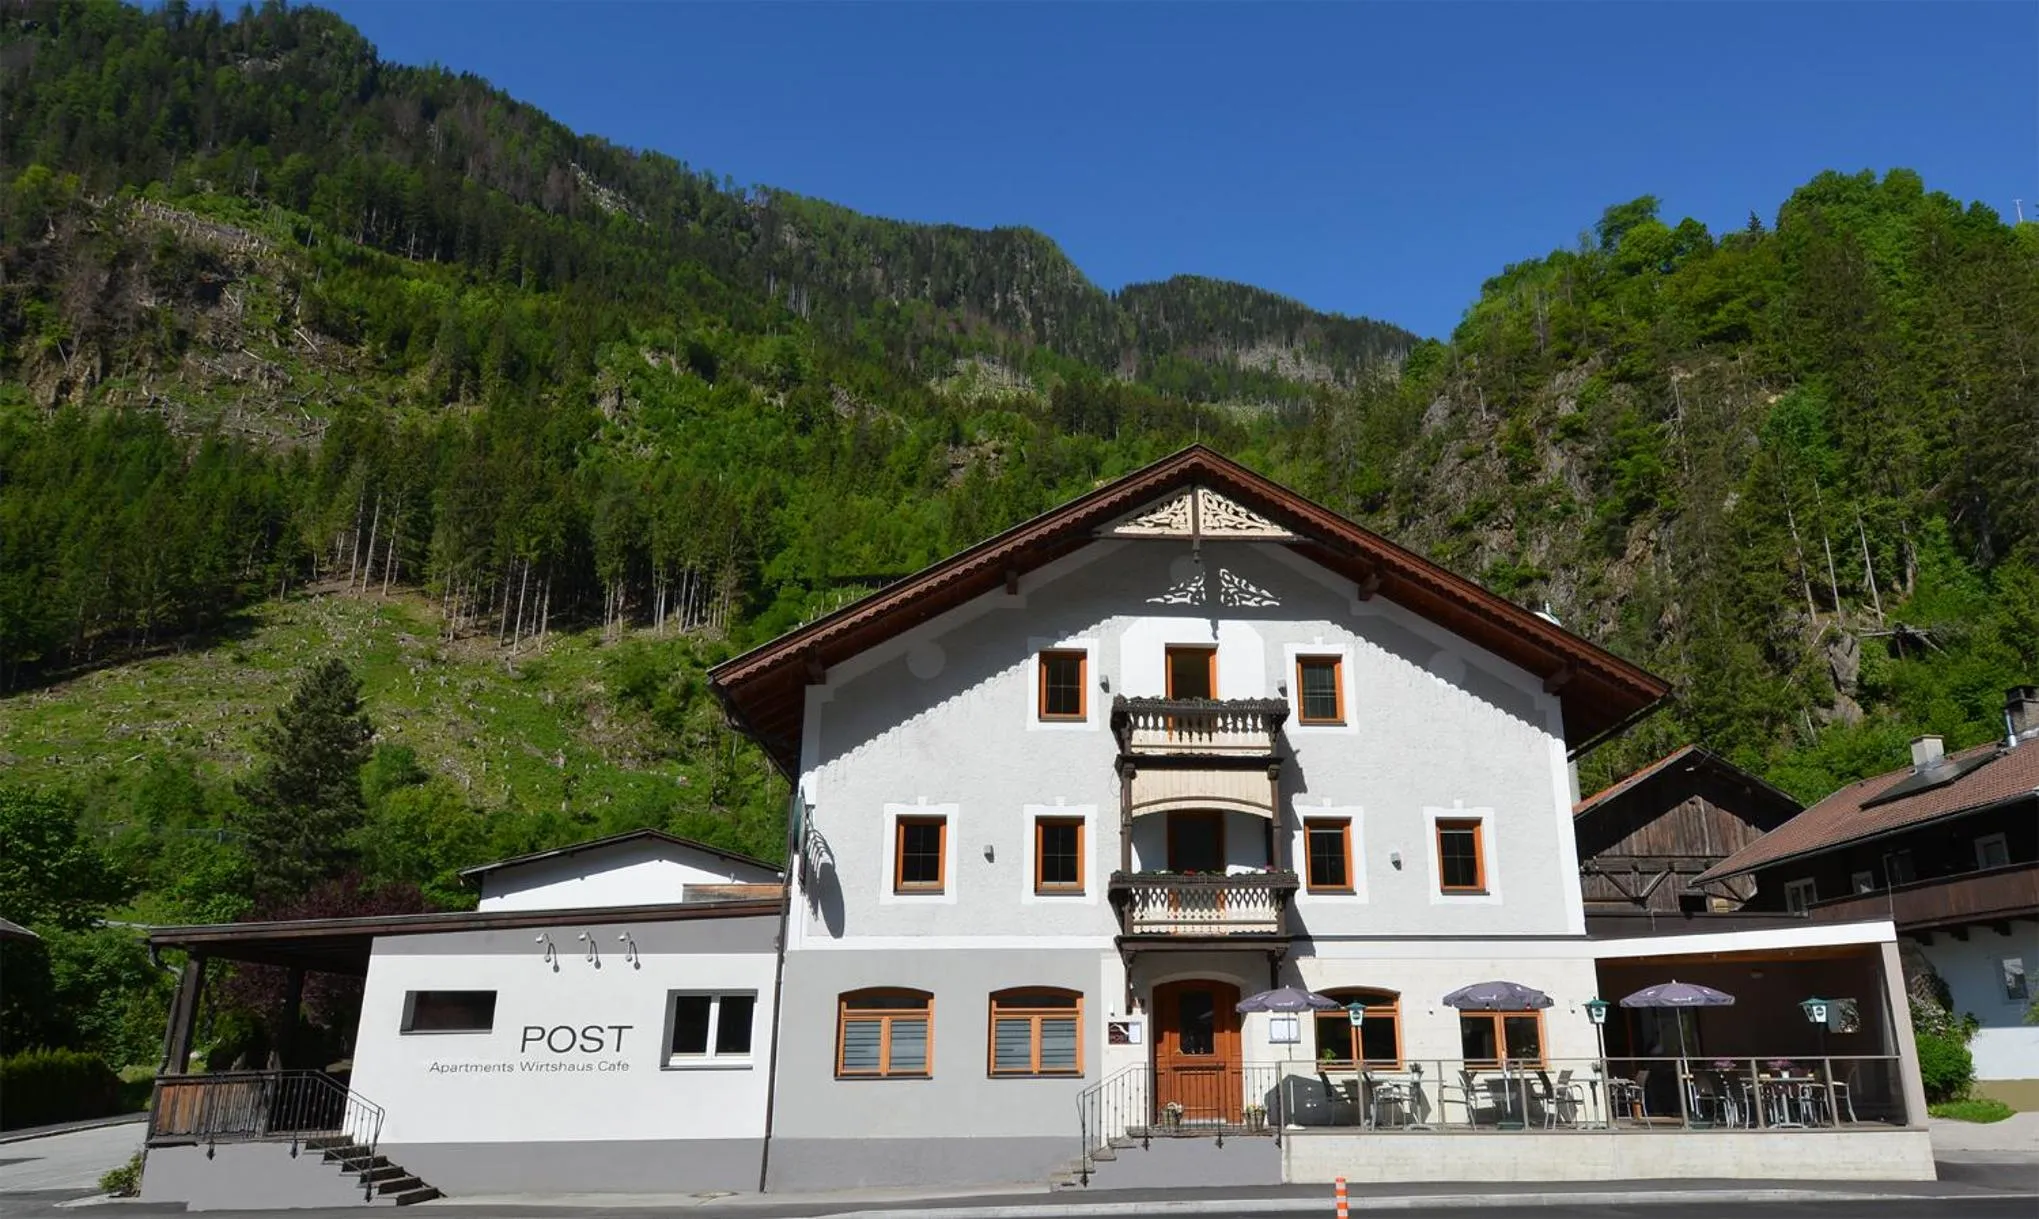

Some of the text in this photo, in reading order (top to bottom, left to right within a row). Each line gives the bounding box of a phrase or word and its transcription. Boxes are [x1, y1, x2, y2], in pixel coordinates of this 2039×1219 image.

[520, 1025, 634, 1054] POST
[429, 1060, 630, 1074] Apartments Wirtshaus Cafe
